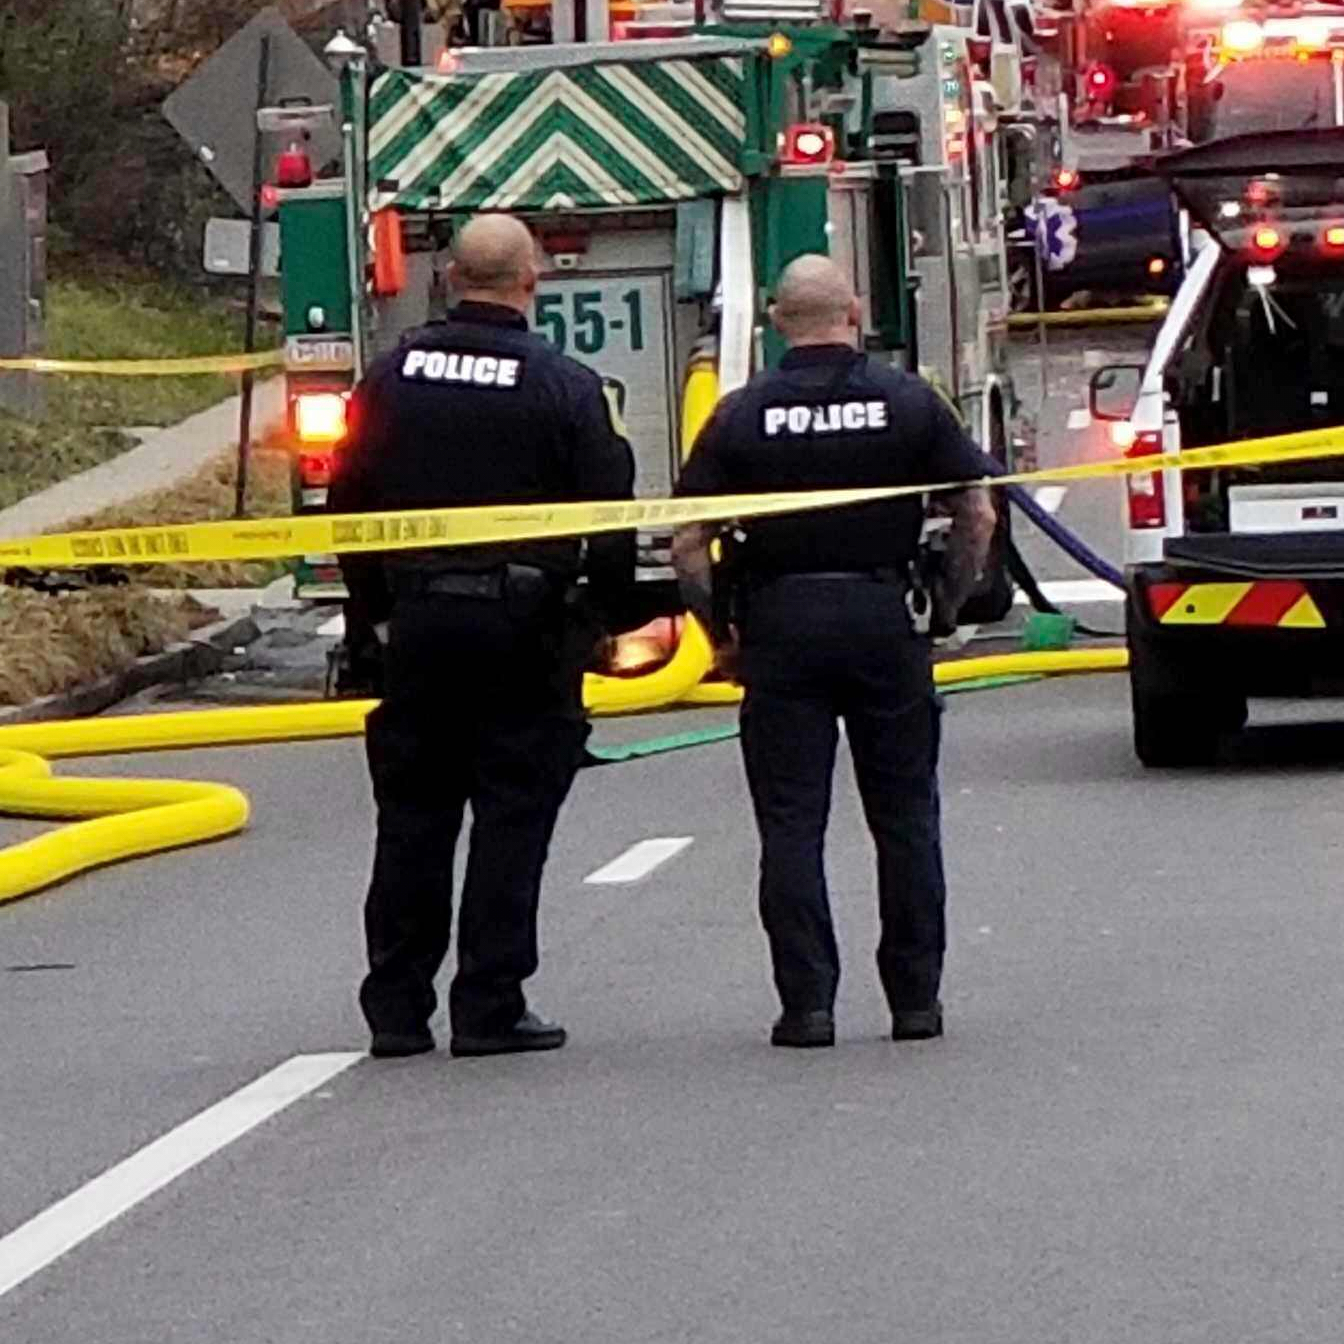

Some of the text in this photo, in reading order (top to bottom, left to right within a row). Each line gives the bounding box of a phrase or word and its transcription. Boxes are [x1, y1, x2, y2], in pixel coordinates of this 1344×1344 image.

[534, 289, 644, 355] 55-1
[402, 350, 521, 388] POLICE
[763, 401, 889, 435] POLICE
